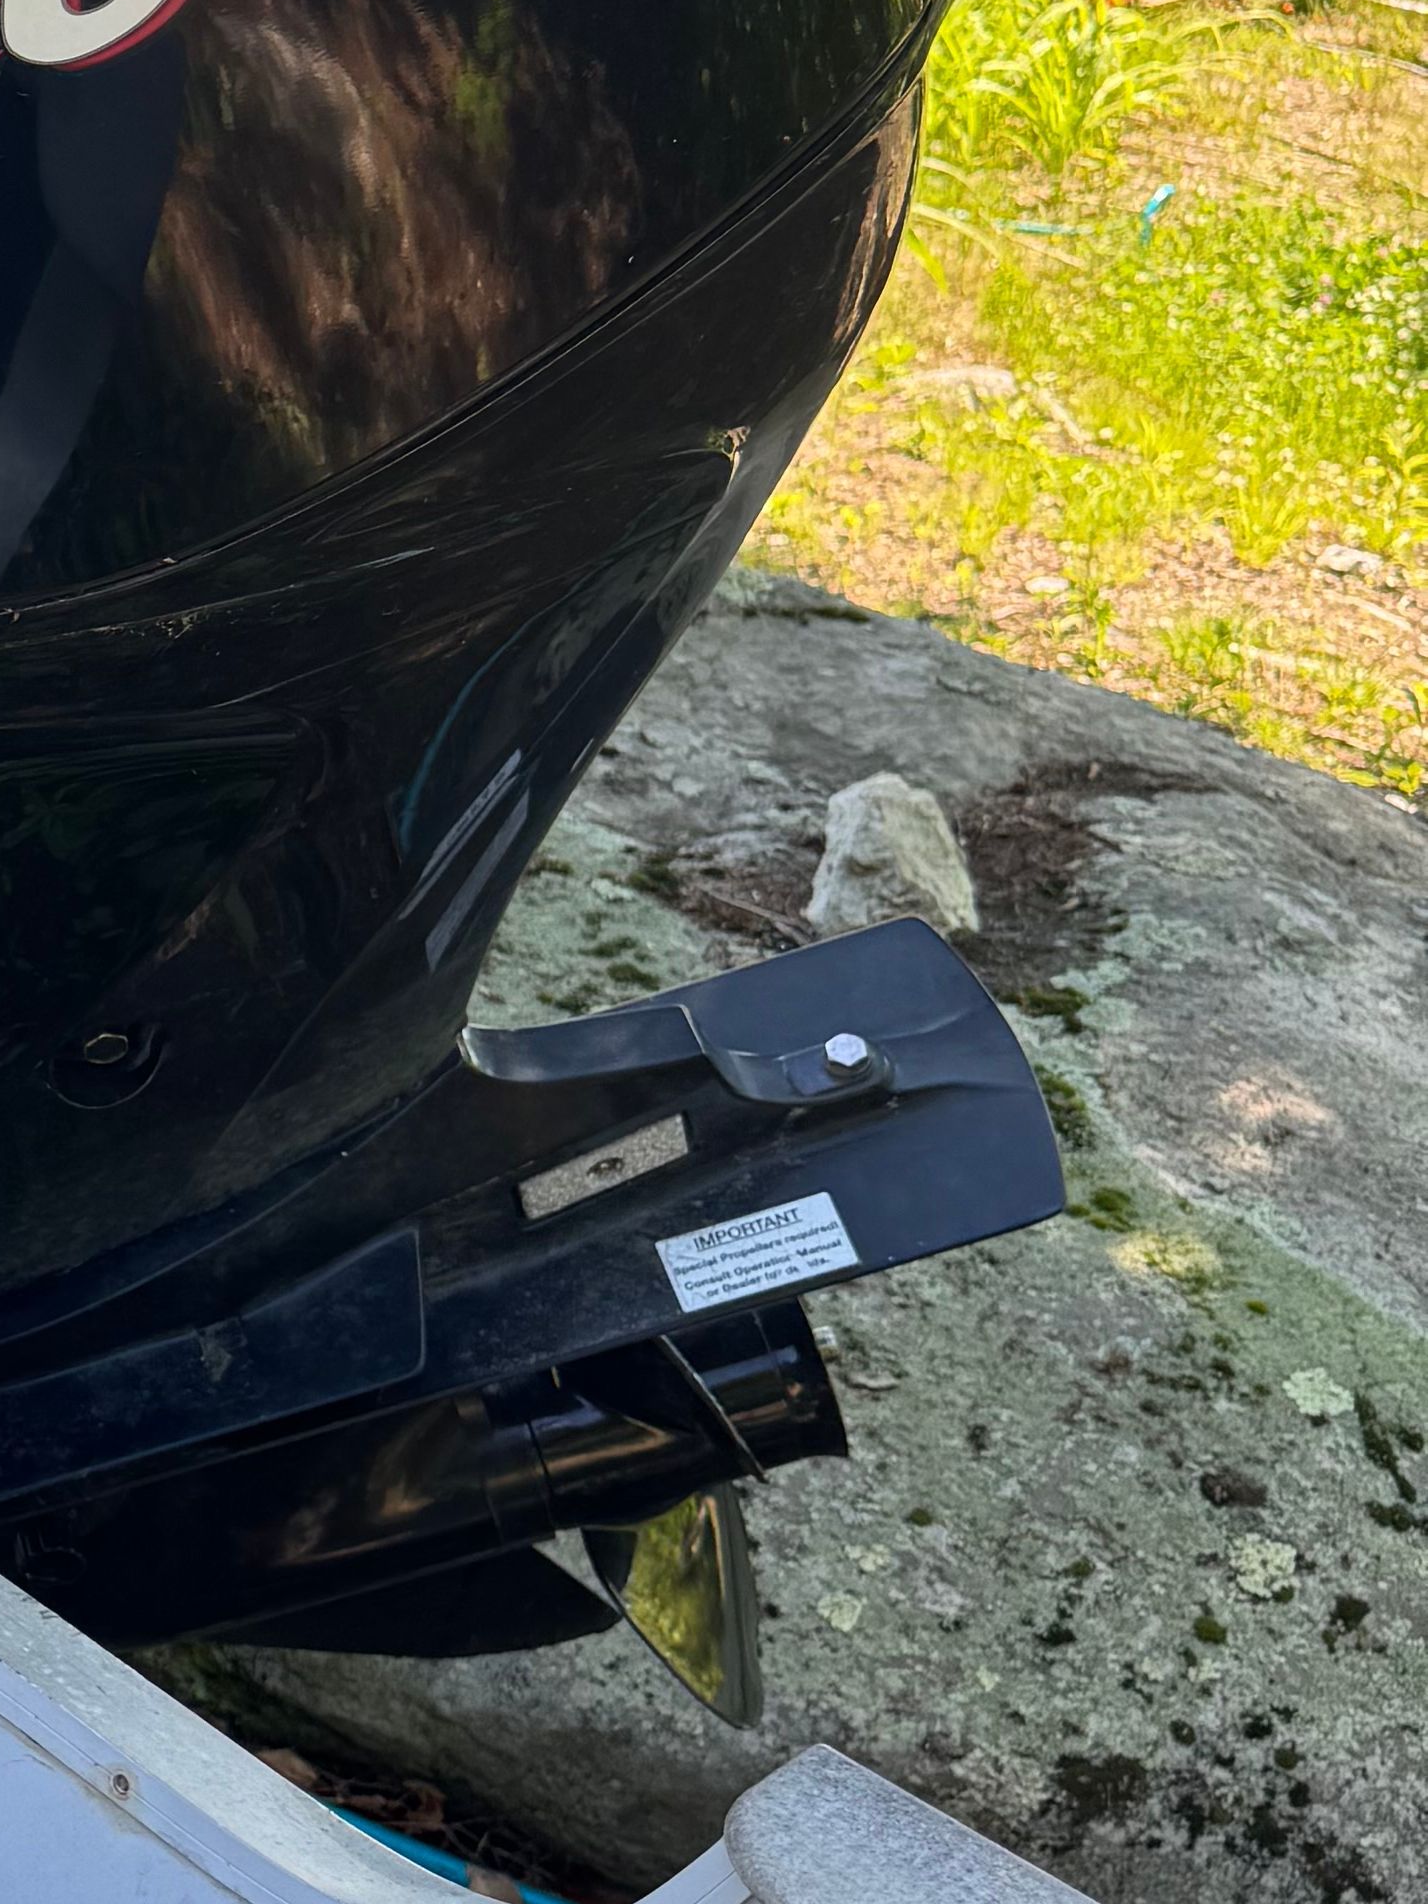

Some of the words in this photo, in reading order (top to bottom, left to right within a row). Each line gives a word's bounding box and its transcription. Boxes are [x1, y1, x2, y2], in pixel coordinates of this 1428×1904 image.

[693, 1207, 800, 1251] IMPORTANT
[684, 1272, 732, 1291] Consult
[796, 1237, 842, 1258] Manual
[722, 1275, 763, 1293] Dealer
